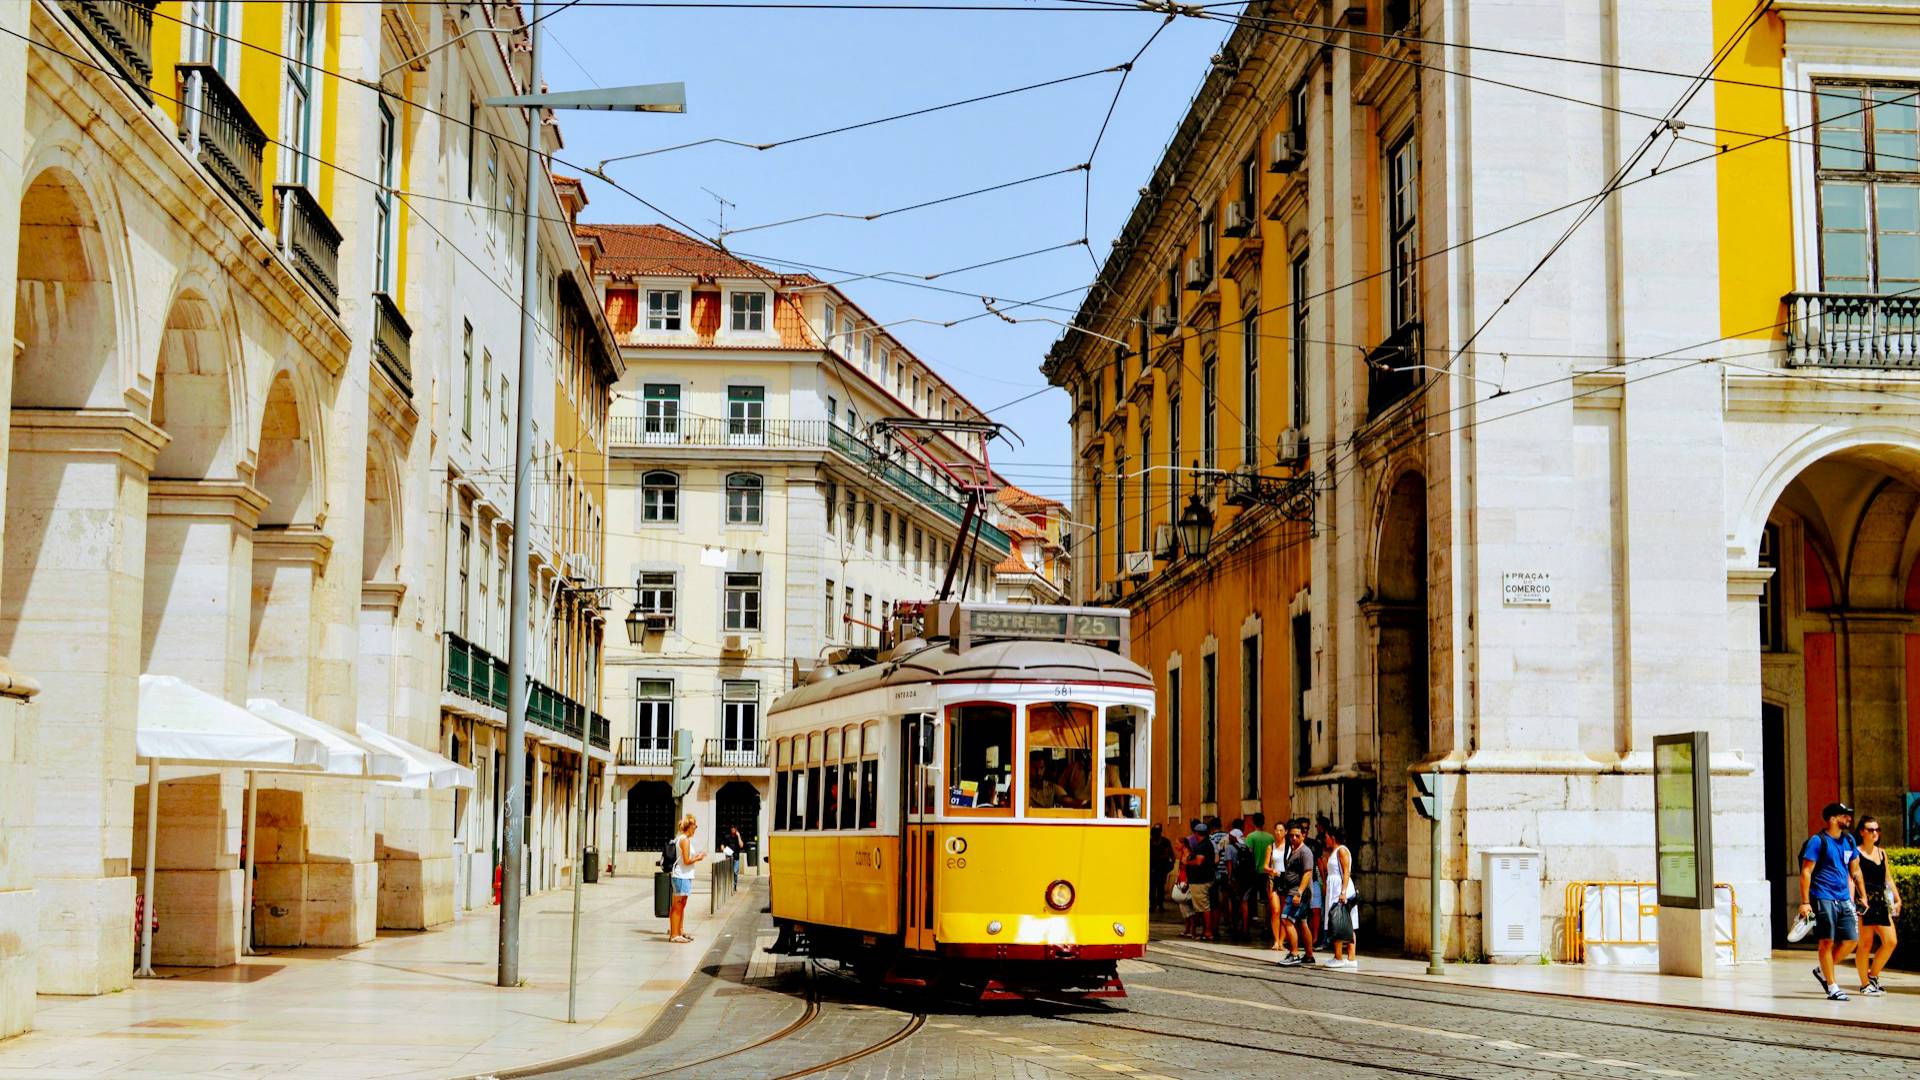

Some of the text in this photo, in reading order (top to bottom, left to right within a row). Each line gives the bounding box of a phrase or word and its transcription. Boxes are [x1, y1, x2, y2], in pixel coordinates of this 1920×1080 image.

[1511, 572, 1544, 581] PRAÇA
[1505, 584, 1551, 593] COMERCIO
[976, 612, 1106, 635] ESTRELA 25
[1054, 686, 1073, 697] 581
